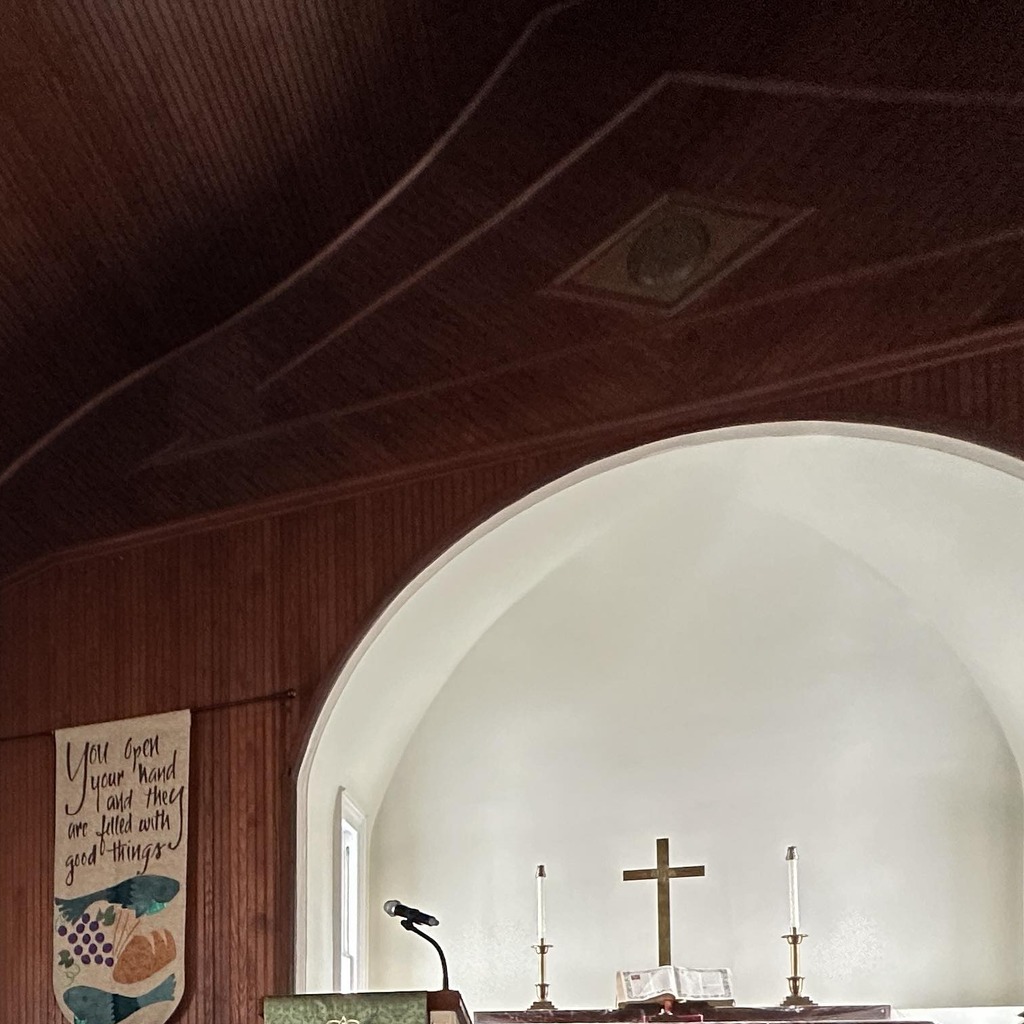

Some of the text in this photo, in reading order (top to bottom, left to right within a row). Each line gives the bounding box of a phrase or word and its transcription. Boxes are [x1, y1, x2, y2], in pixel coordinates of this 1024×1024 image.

[65, 735, 160, 816] You open
[90, 749, 178, 813] your hand
[67, 809, 171, 856] are filled with
[106, 785, 185, 850] and they
[65, 840, 167, 887] good things
